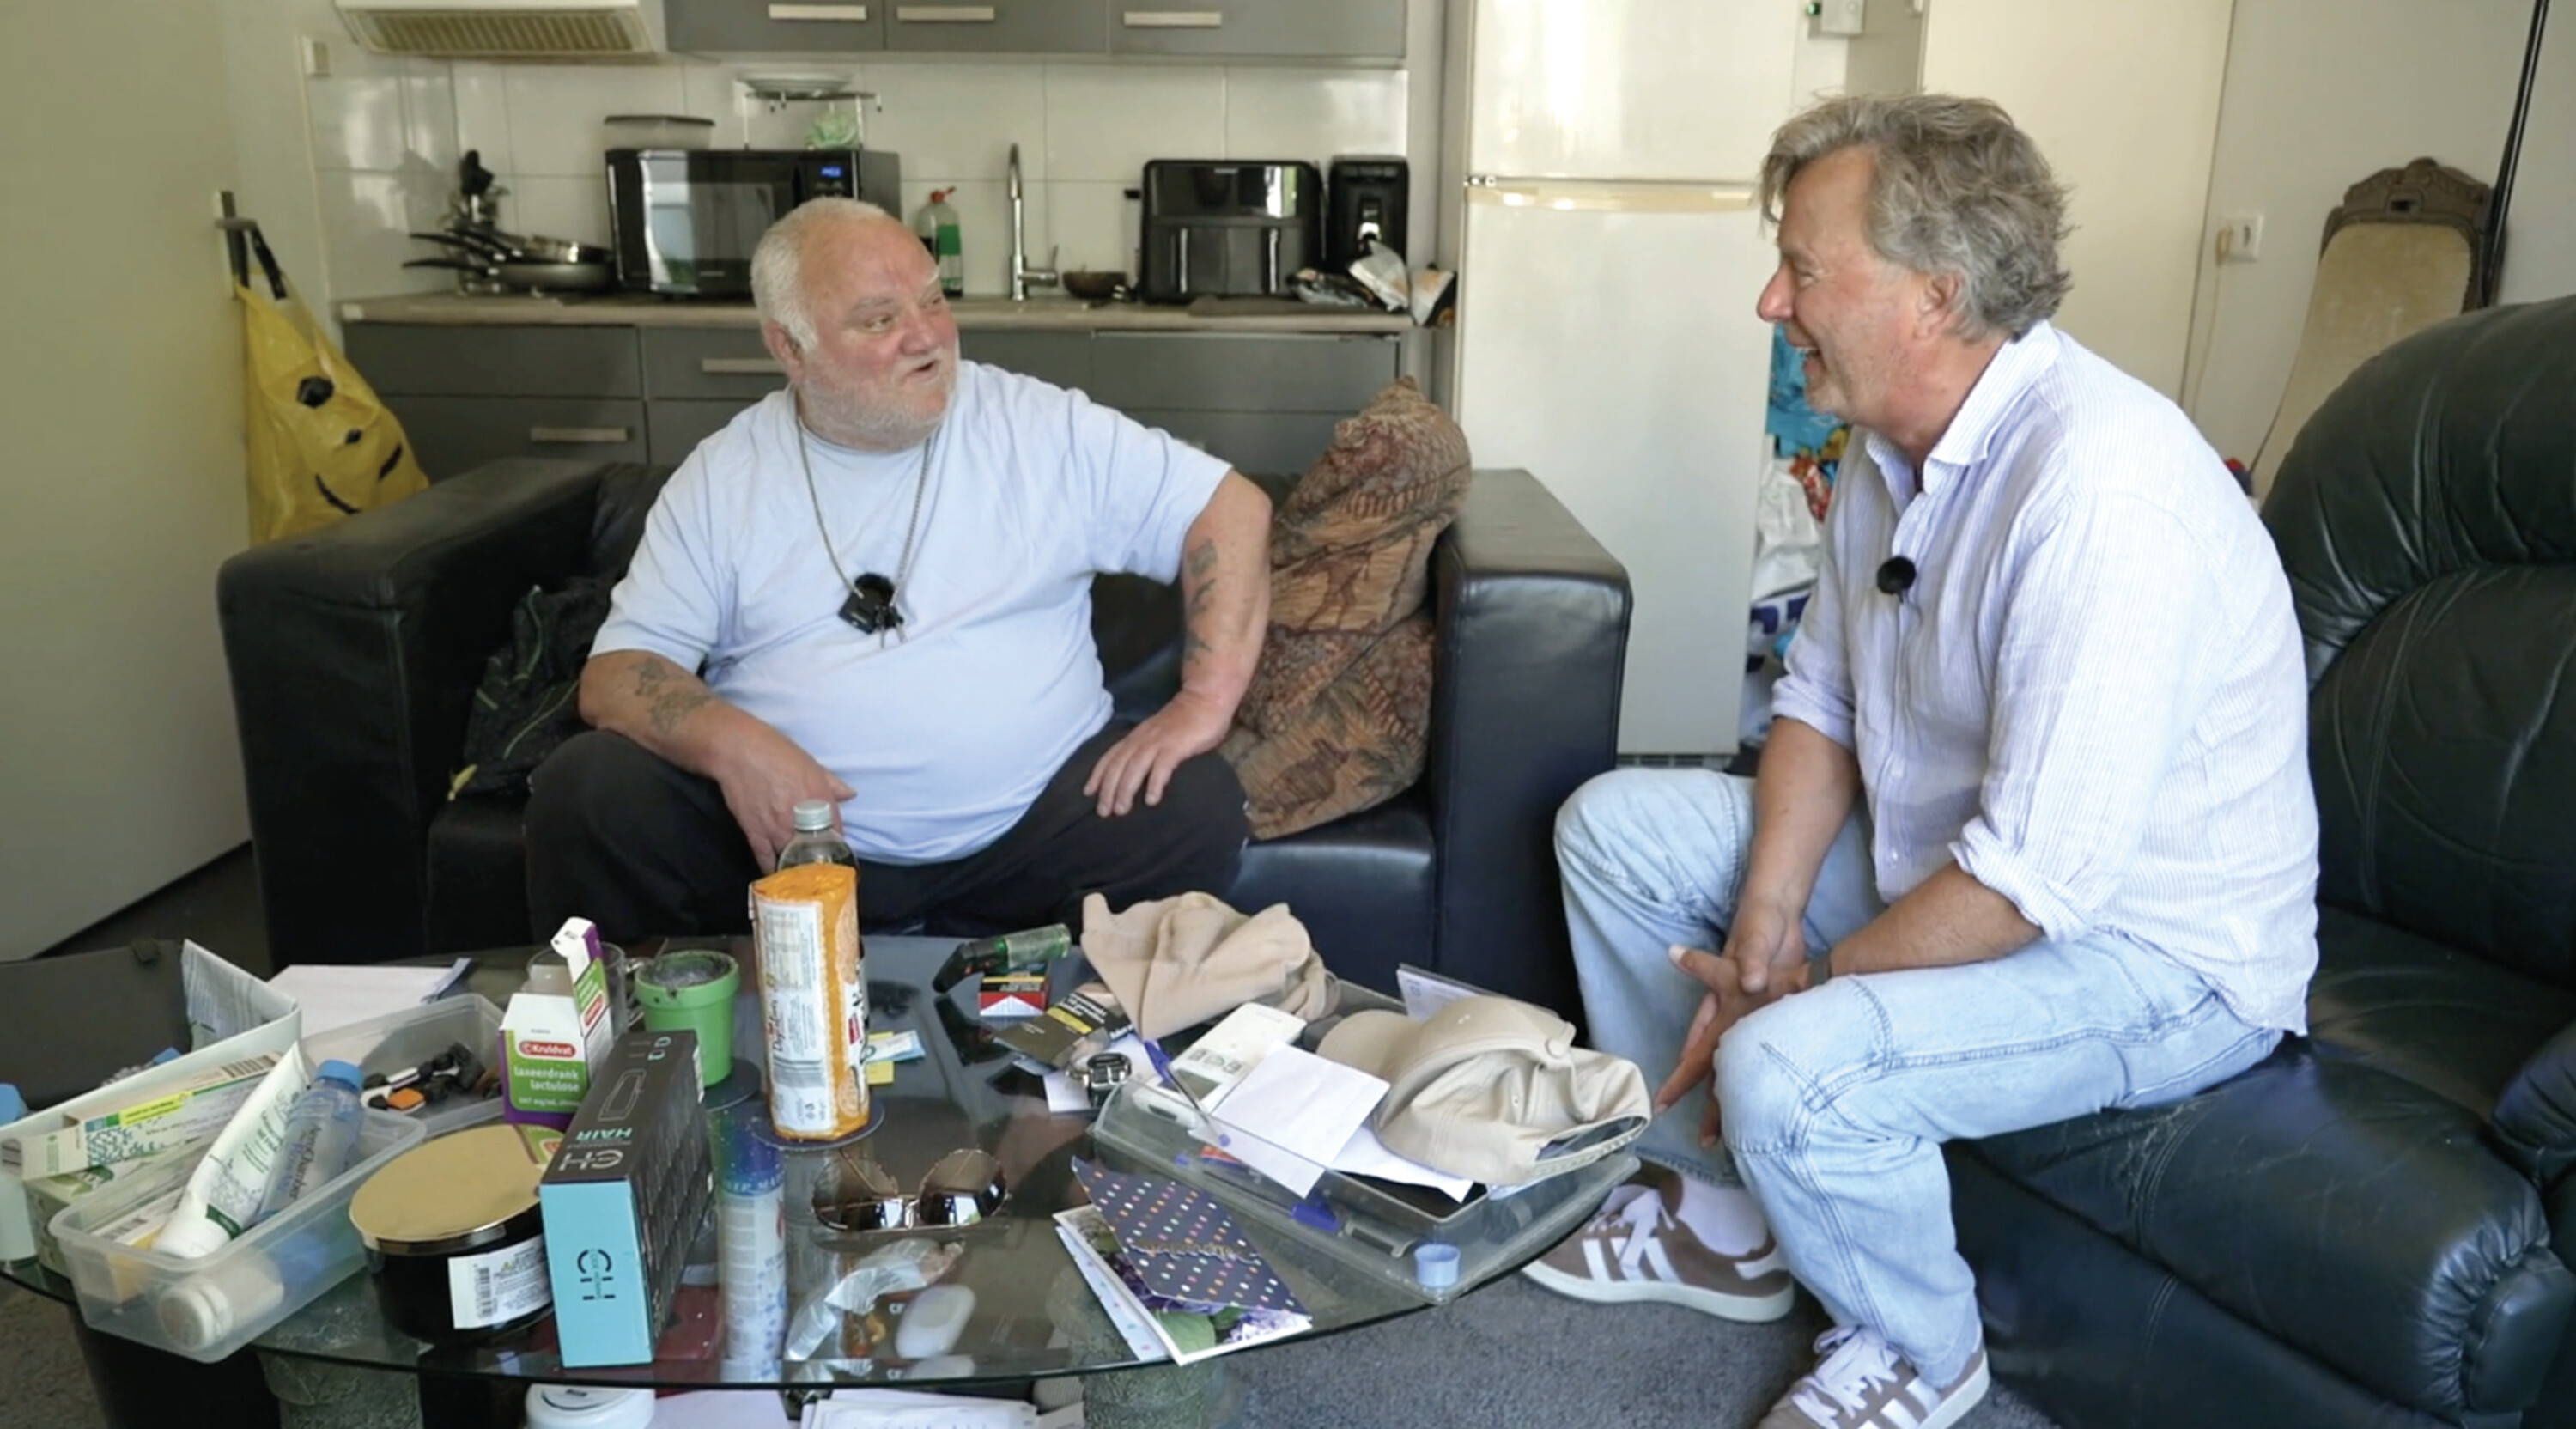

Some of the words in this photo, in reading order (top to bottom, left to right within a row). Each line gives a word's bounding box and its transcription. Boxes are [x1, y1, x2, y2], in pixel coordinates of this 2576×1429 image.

[530, 1079, 580, 1092] lactulose
[576, 1128, 633, 1140] HAIR
[577, 1249, 616, 1301] CH
